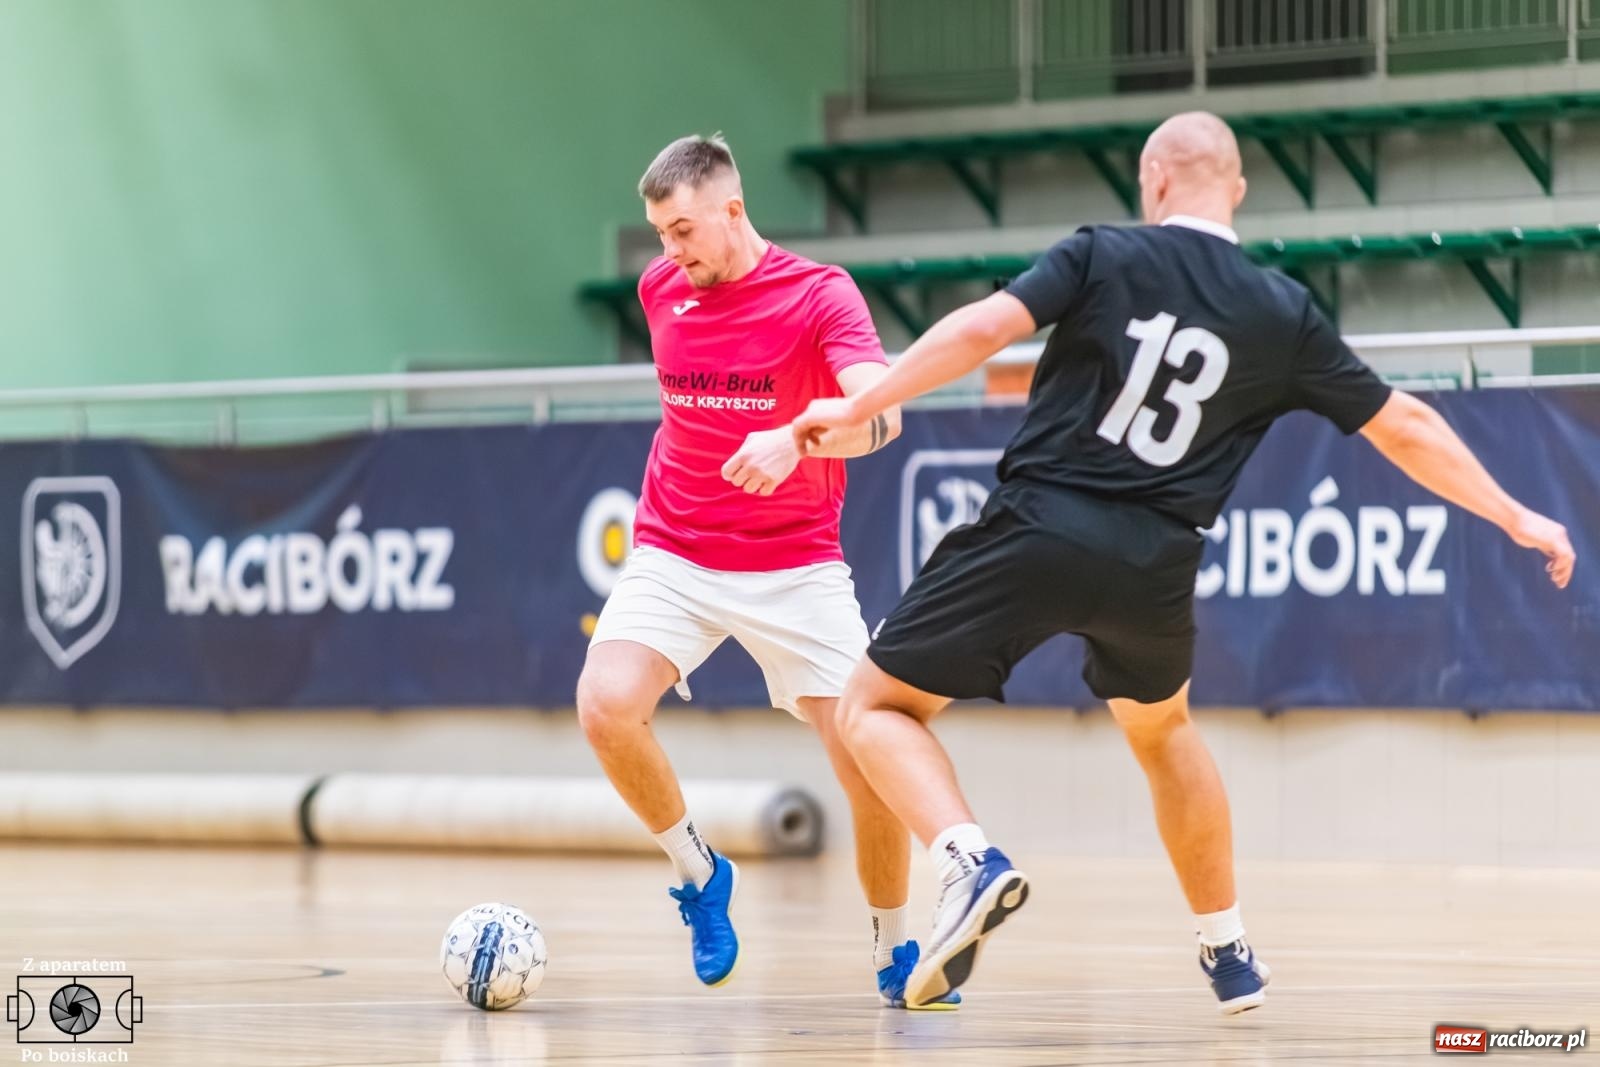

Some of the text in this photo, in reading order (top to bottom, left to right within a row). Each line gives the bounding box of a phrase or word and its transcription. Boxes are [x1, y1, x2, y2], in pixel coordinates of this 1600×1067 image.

[697, 396, 776, 410] KRZYSZTOF
[1096, 311, 1230, 467] 13
[160, 505, 455, 616] RACIBÓRZ
[1193, 476, 1448, 598] CIBÓRZ
